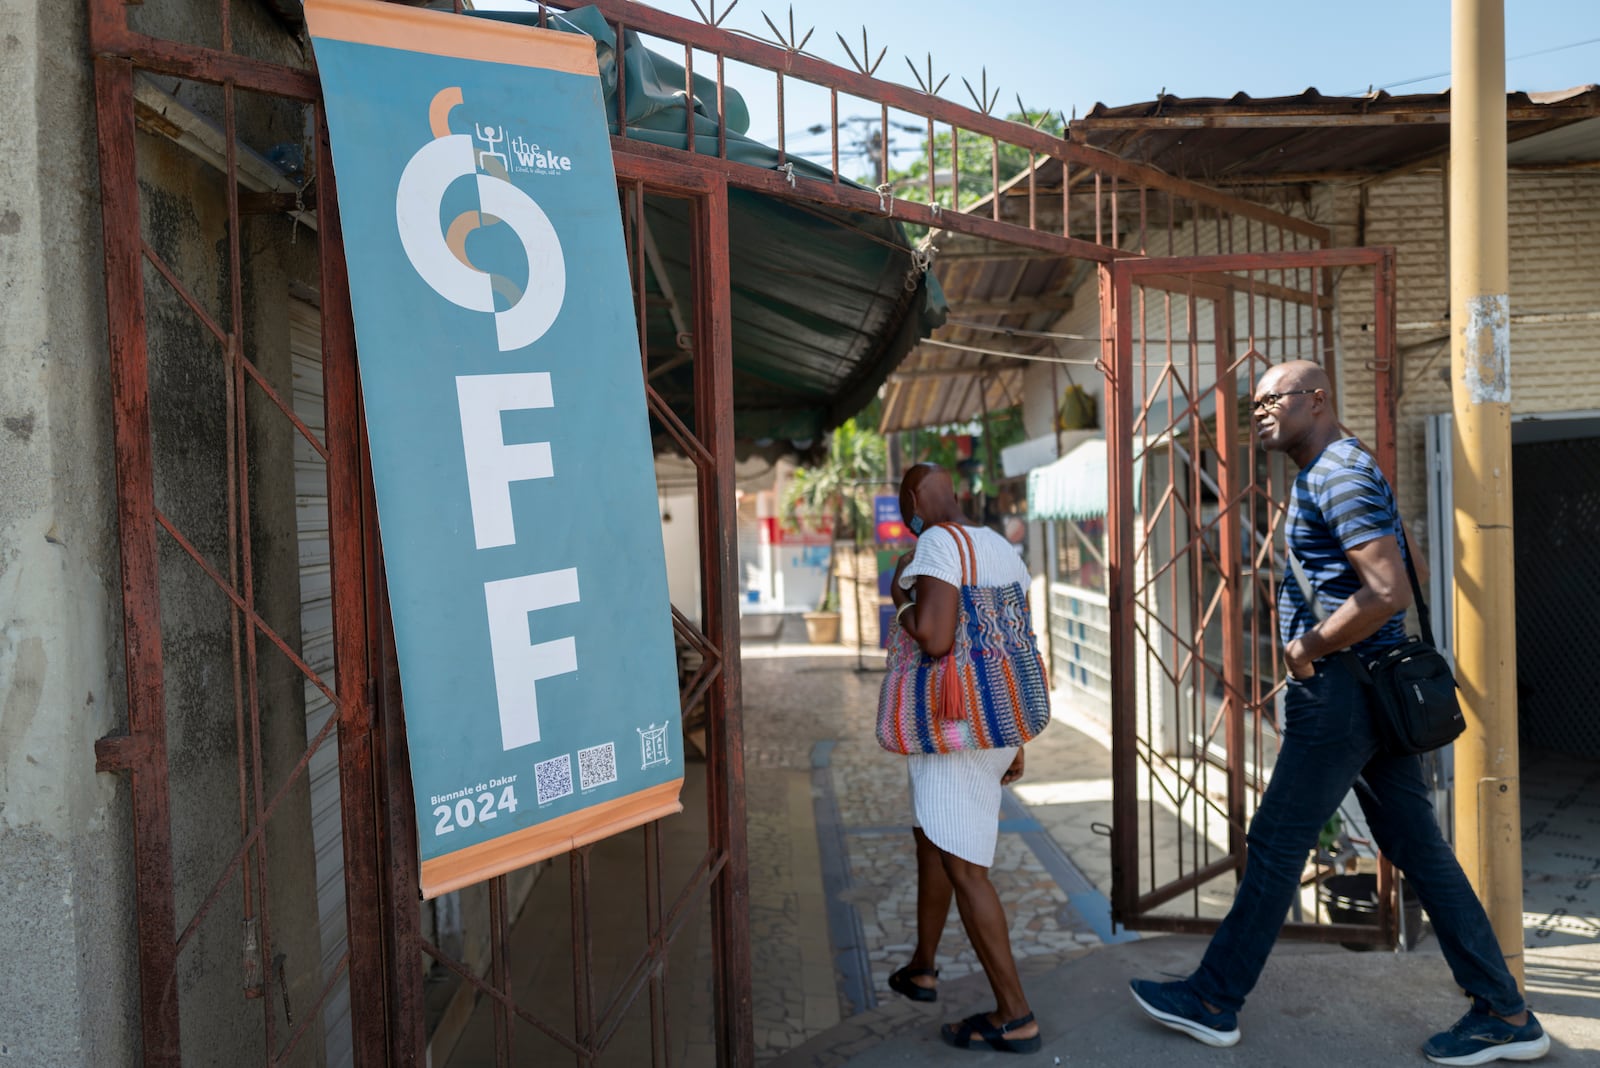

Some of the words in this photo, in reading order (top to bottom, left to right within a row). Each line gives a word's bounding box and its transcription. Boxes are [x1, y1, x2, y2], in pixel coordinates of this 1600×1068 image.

[511, 136, 540, 155] the
[517, 150, 572, 171] wake
[396, 134, 581, 752] OFF
[431, 787, 474, 805] Biennale
[475, 783, 488, 792] de
[489, 775, 517, 788] Dakar
[433, 785, 518, 836] 2024
